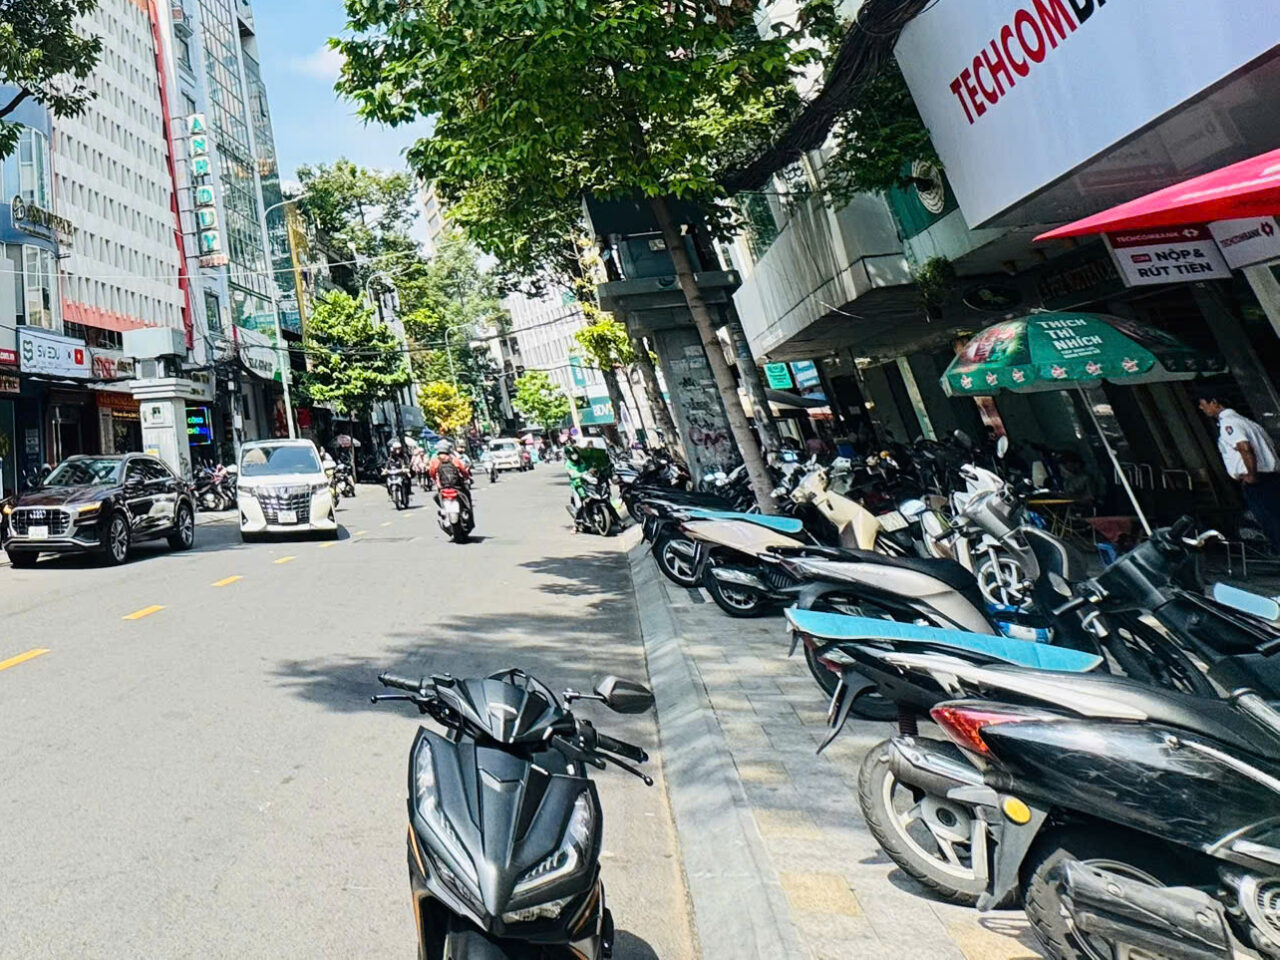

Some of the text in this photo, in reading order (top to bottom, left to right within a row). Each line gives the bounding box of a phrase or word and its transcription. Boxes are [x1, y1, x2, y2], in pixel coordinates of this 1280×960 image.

[191, 117, 208, 173] ANH
[198, 189, 217, 251] DUY
[1137, 265, 1170, 278] RÚT
[1036, 318, 1088, 329] THÍCH
[1052, 335, 1104, 350] NHÍCH
